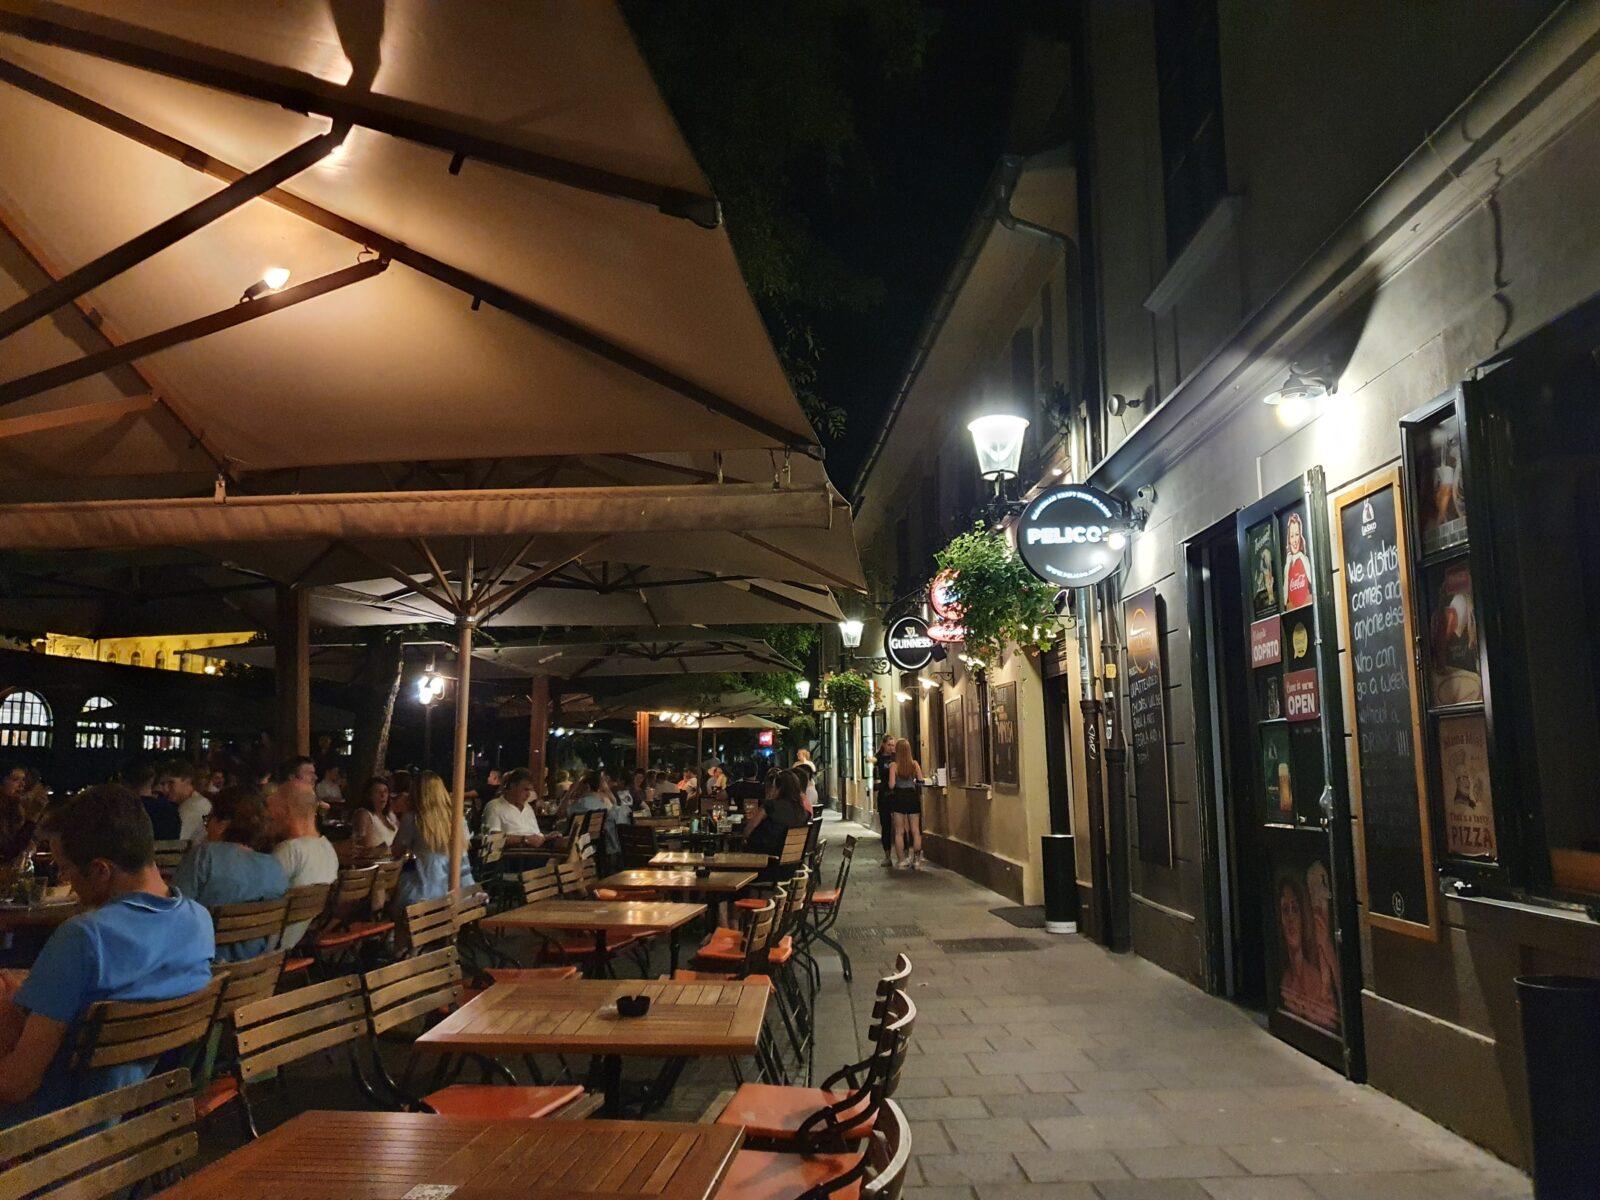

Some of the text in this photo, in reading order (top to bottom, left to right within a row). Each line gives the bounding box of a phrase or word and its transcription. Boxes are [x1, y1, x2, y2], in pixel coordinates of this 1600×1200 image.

[1347, 561, 1364, 584] We
[890, 638, 934, 650] GUINNESS
[1288, 693, 1315, 716] OPEN
[1451, 827, 1493, 849] PIZZA
